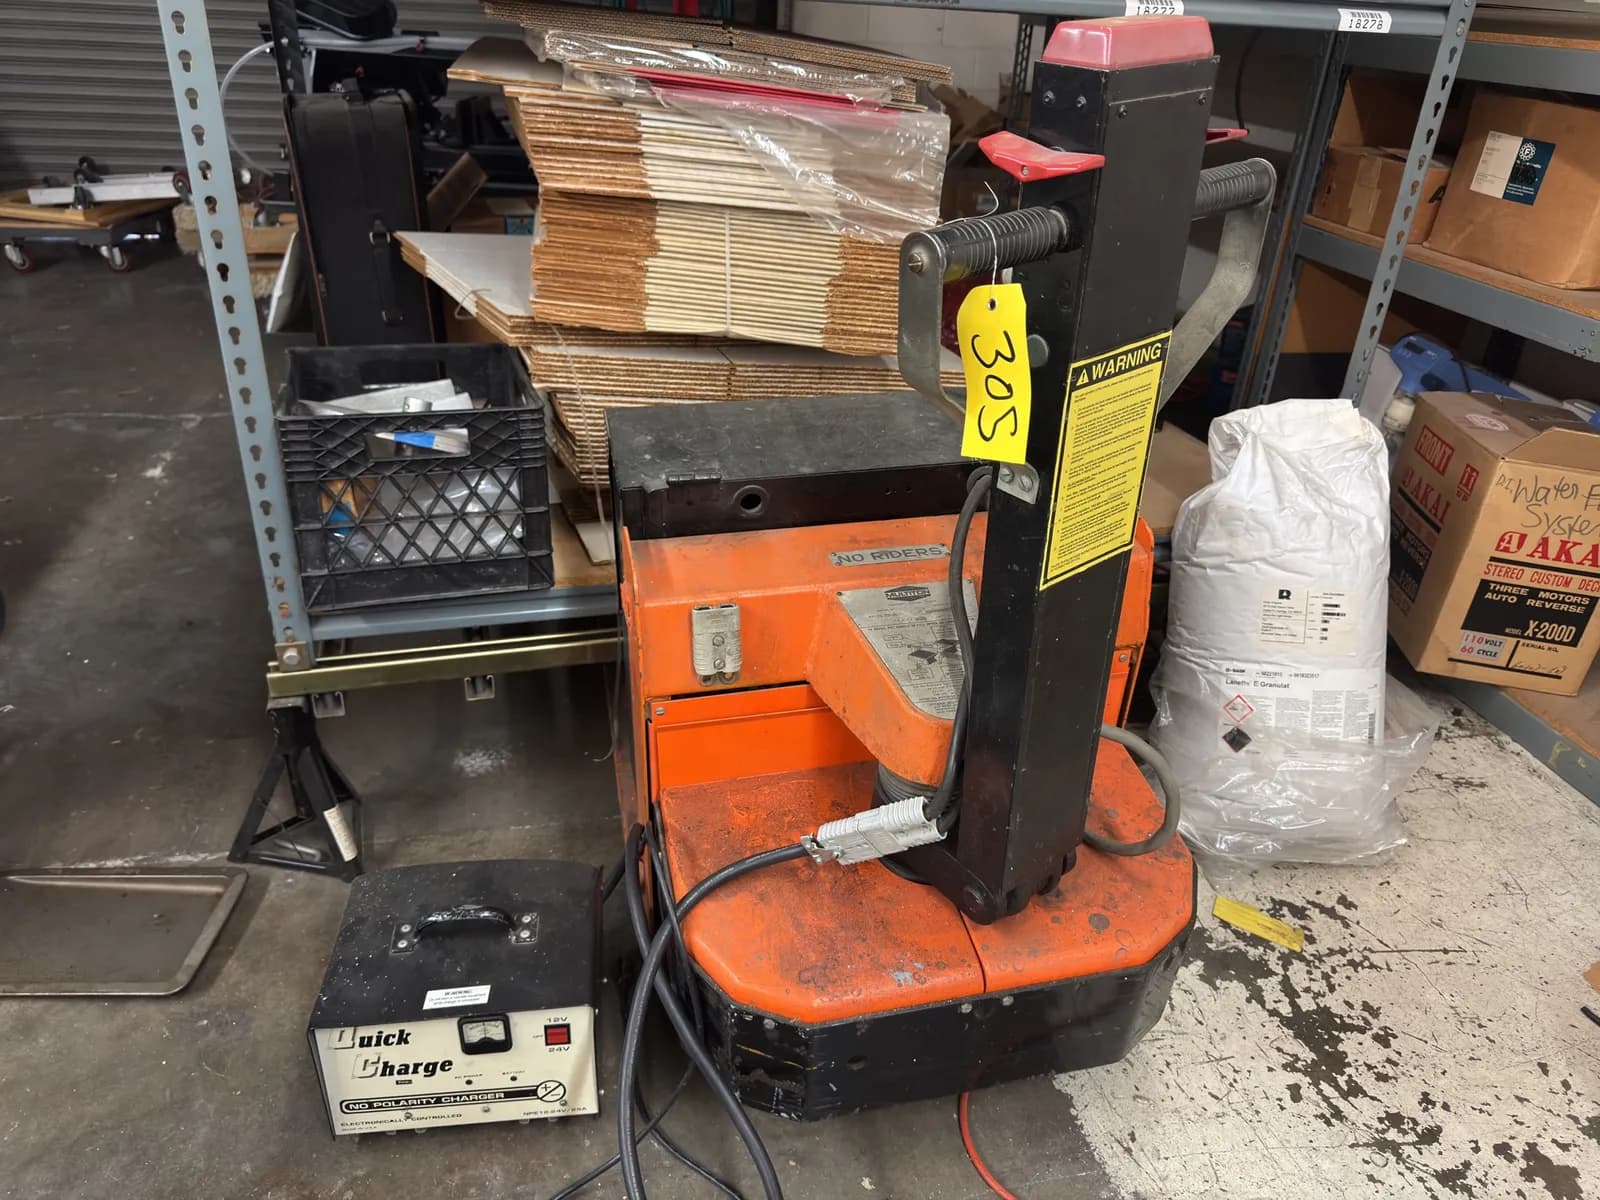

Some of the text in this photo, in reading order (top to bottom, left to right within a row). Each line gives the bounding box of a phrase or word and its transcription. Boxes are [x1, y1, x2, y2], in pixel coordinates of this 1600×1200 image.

[1349, 18, 1383, 30] 18278
[1092, 343, 1162, 380] WARNING
[971, 330, 1018, 442] 305
[1417, 431, 1451, 474] FRONT
[1512, 475, 1579, 505] Water
[837, 546, 943, 564] NO RIDERS
[1484, 563, 1525, 580] STEREO
[1530, 570, 1573, 588] CUSTOM
[1484, 592, 1586, 614] AUTO REVERSE
[1488, 583, 1590, 605] THREE MOTORS
[1464, 633, 1503, 648] 110 VOLT
[1523, 619, 1576, 643] X-200D
[1460, 645, 1499, 658] 60 CYCLE
[547, 1016, 568, 1024] 12V
[352, 1052, 454, 1079] Charge
[349, 1092, 505, 1110] NO POLARITY CHARGER
[411, 1113, 463, 1122] CONTROLLED
